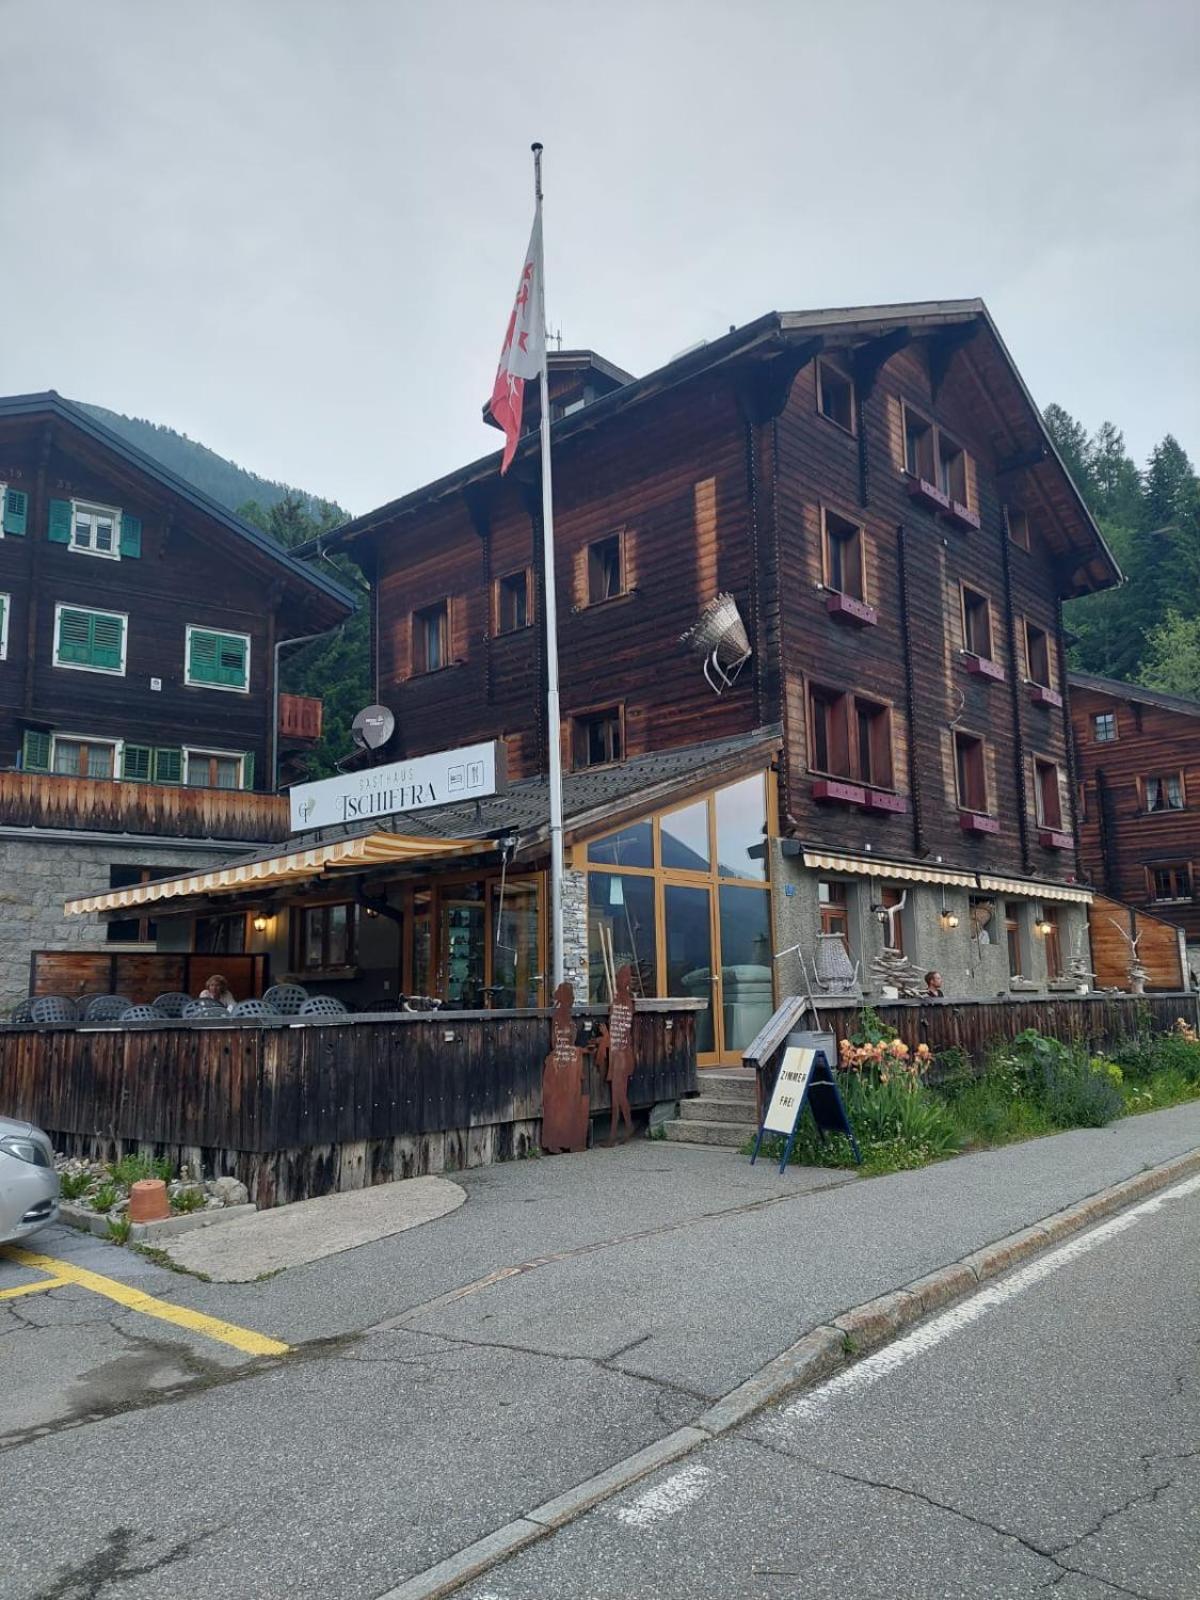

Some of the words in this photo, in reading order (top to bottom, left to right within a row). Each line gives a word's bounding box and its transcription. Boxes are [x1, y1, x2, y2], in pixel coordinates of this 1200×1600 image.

[359, 767, 414, 791] GASTHAUS
[335, 781, 436, 821] TSCHIFFRA
[780, 1070, 806, 1083] ZIMMER
[779, 1095, 794, 1108] FREI
